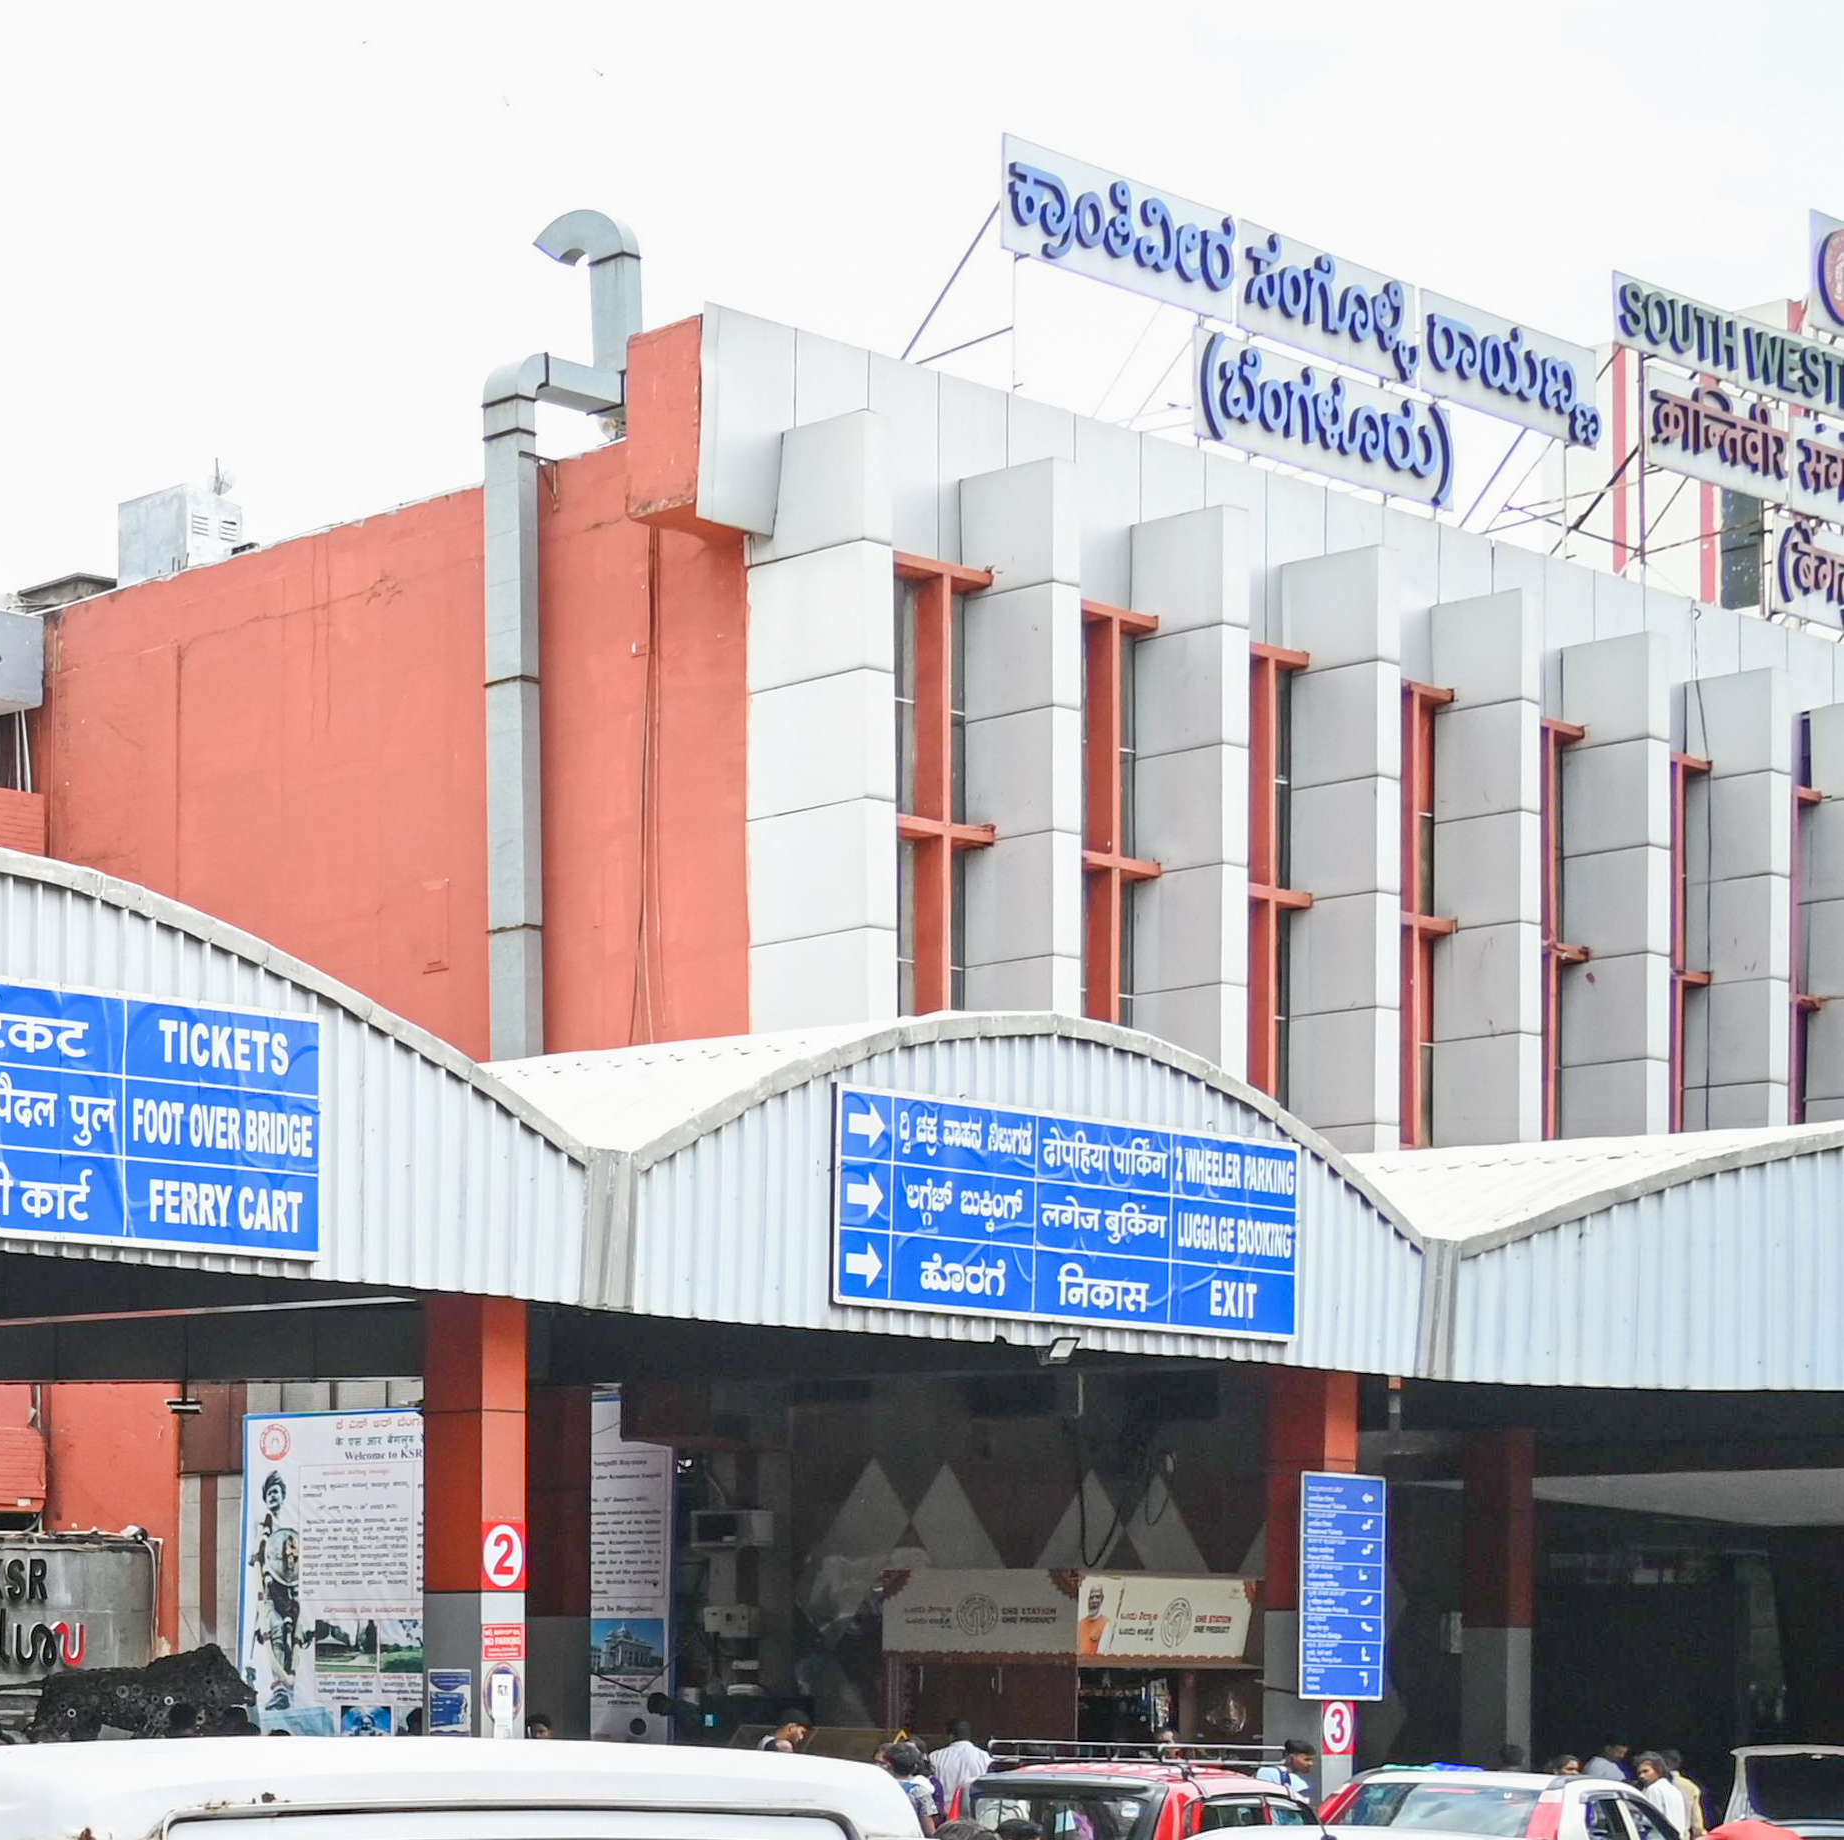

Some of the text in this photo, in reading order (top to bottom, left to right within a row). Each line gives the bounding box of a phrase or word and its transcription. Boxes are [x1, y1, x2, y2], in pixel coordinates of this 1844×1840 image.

[1008, 161, 1235, 291] ಕ್ರಾಂತಿವೀರ
[1619, 282, 1738, 371] SOUTH
[158, 1019, 289, 1076] TICKETS
[69, 1095, 116, 1146] पुल
[133, 1098, 313, 1158] FOOT OVER BRIDGE
[1175, 1146, 1295, 1195] 2 WHEELER PARKING
[20, 1169, 93, 1222] कार्ट
[149, 1179, 303, 1233] FERRY CART
[1041, 1196, 1167, 1244] लगेज बुकिंग
[1177, 1212, 1293, 1258] LUGGAGE BOOKING
[920, 1252, 1006, 1297] ಹೊರಗೆ
[1057, 1262, 1150, 1312] निकास
[1210, 1280, 1258, 1319] EXIT
[344, 1449, 423, 1461] Welcome to KSR
[493, 1532, 514, 1578] 2
[1002, 1607, 1057, 1616] ONE STATION
[1002, 1616, 1057, 1625] ONE PRODUCT
[1193, 1625, 1230, 1635] ONE PRODUCT
[1195, 1615, 1232, 1624] ONE STATION
[495, 1638, 521, 1646] PARKING
[1330, 1708, 1345, 1744] 3
